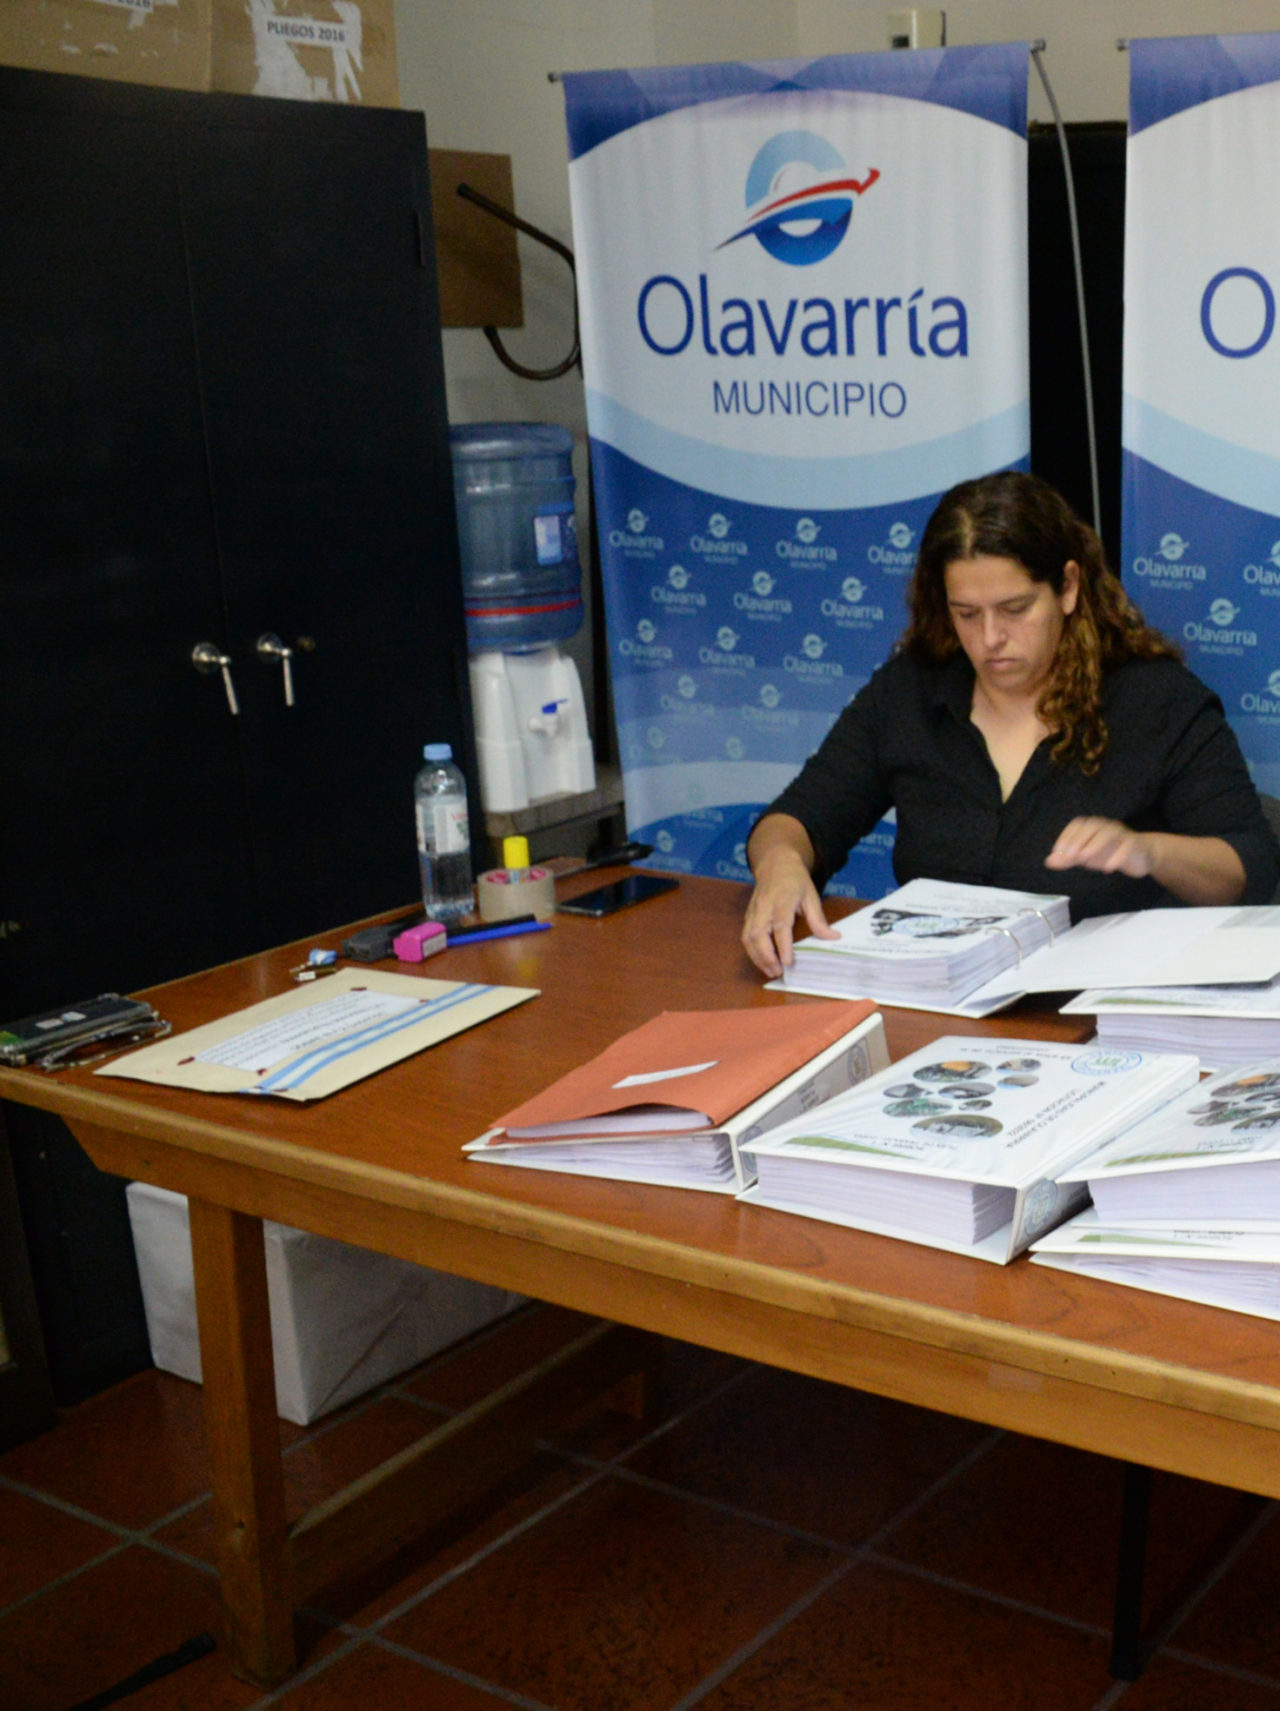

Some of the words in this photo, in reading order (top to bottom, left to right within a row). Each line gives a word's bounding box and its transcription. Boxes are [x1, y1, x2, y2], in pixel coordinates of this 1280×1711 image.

[267, 20, 315, 38] PLIEGOS
[318, 27, 346, 42] 2016
[637, 273, 969, 358] Olavarría
[713, 381, 907, 418] MUNICIPIO
